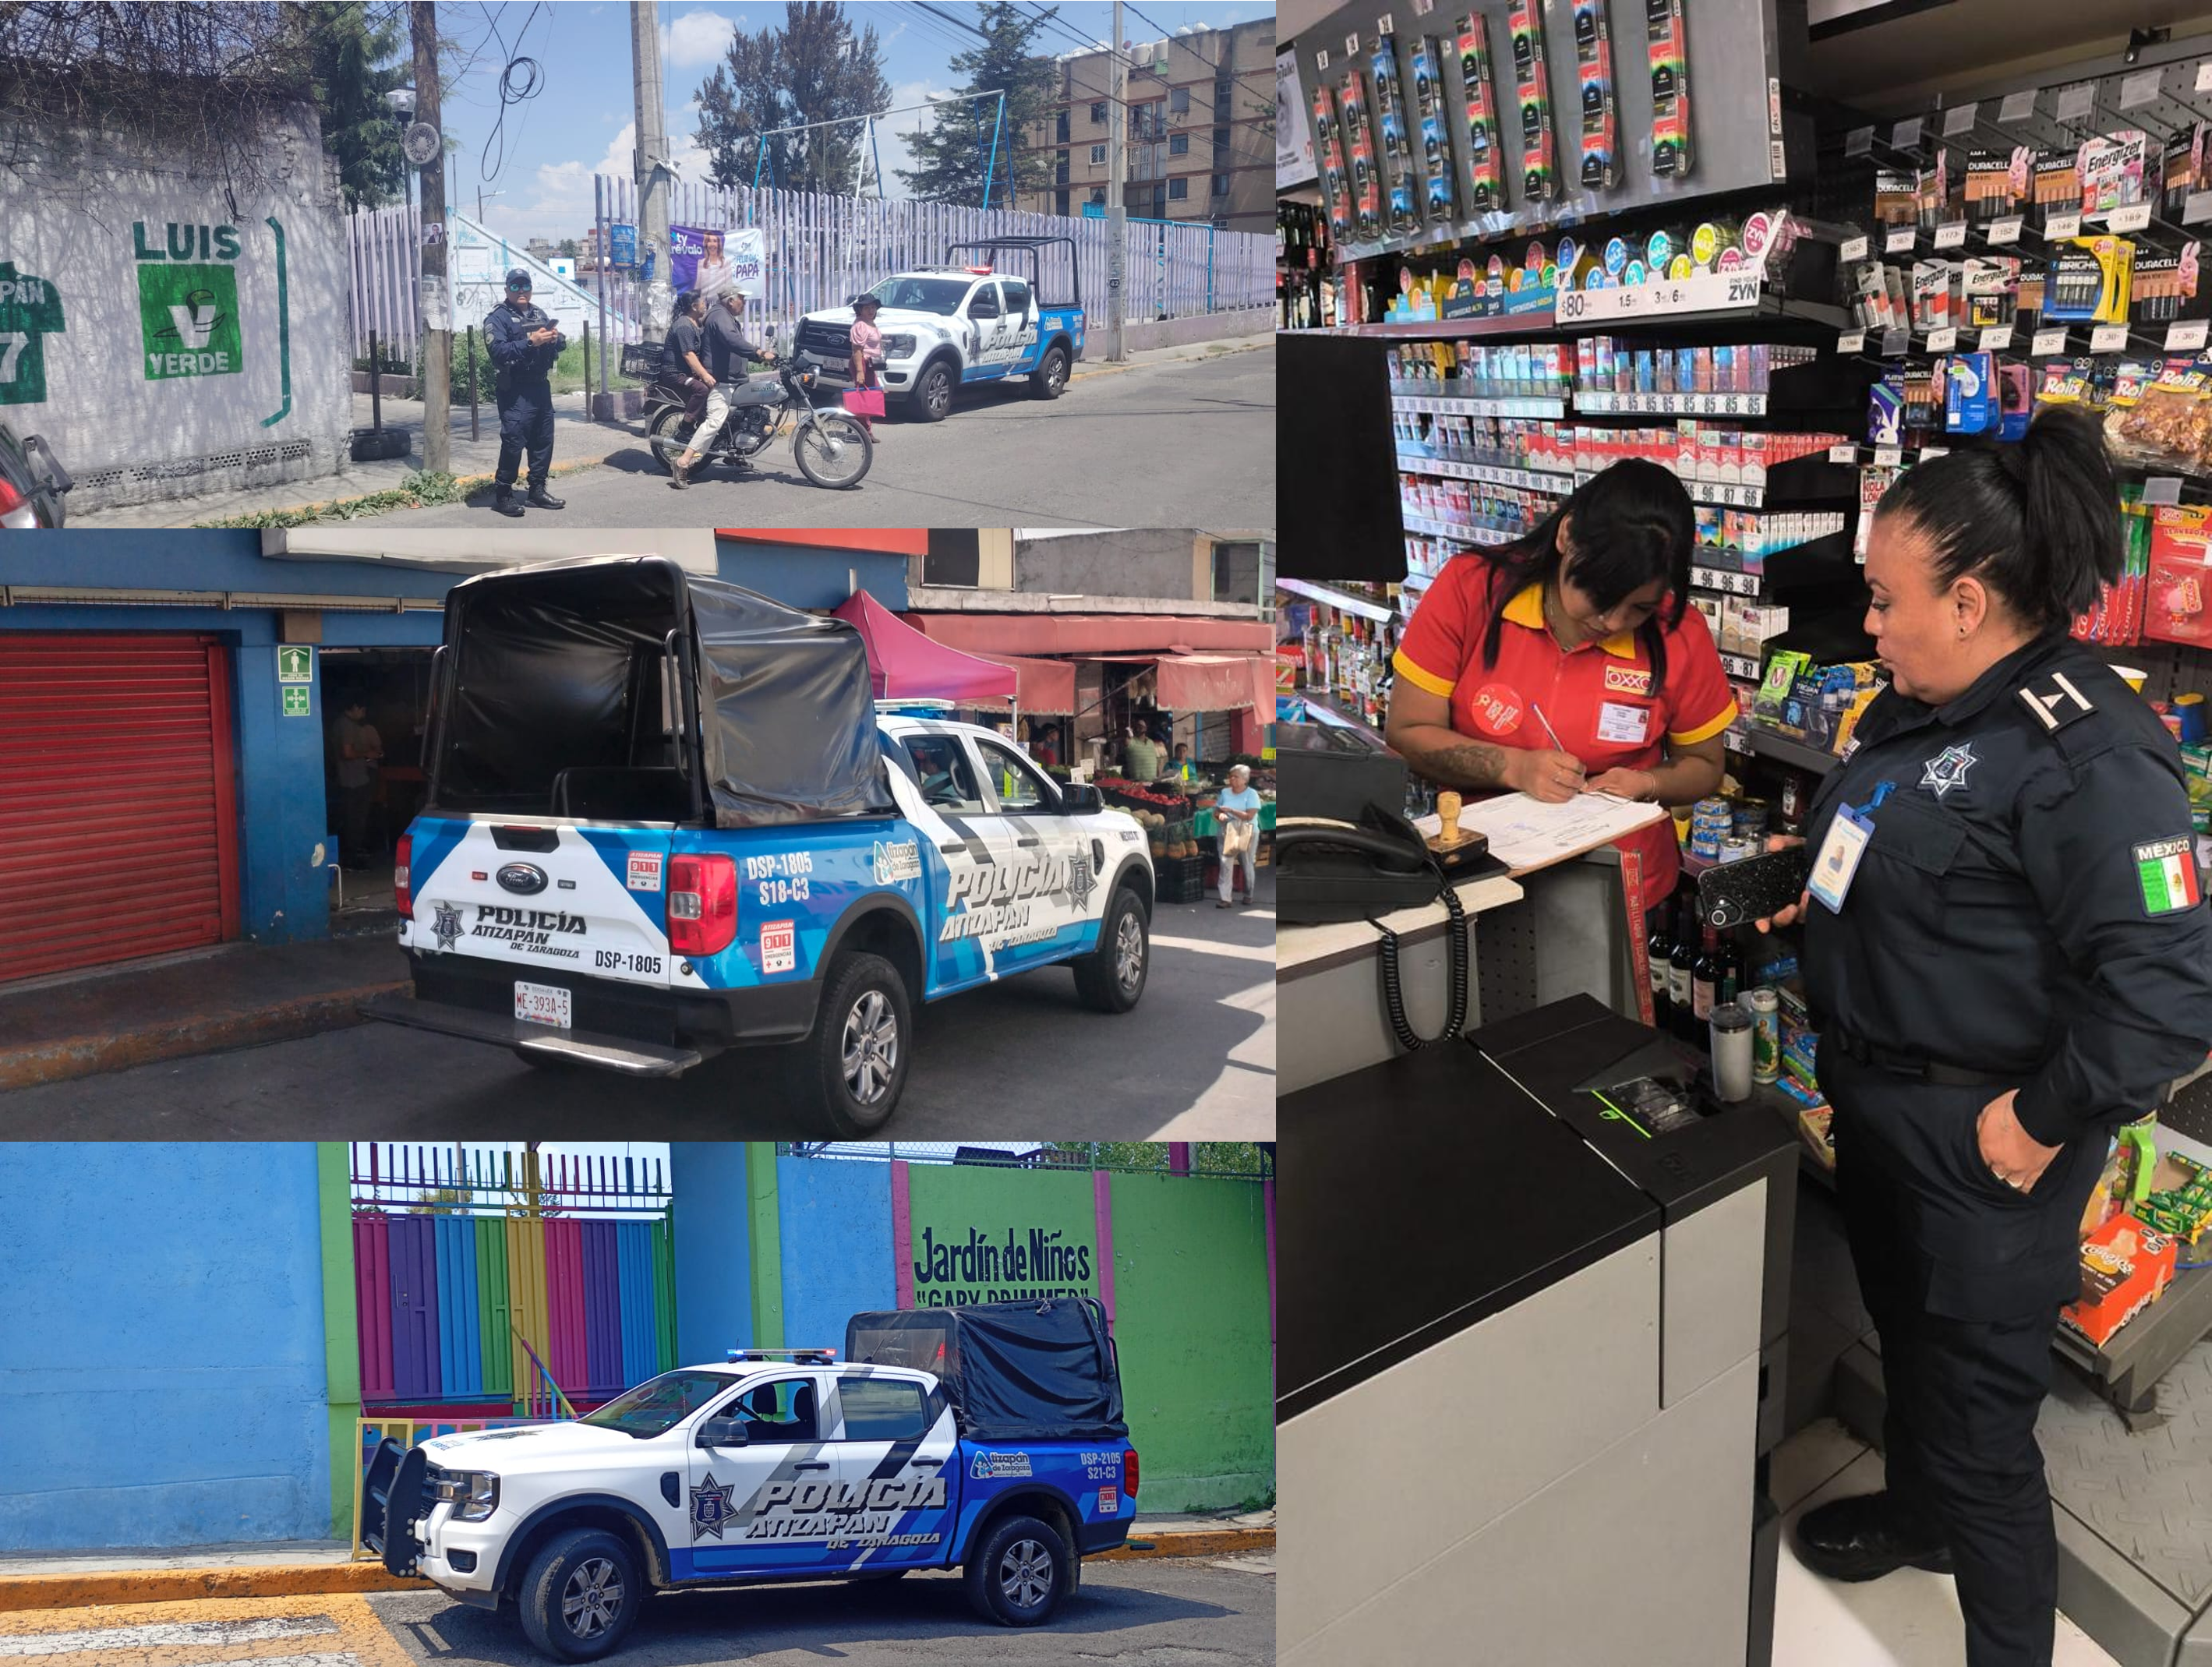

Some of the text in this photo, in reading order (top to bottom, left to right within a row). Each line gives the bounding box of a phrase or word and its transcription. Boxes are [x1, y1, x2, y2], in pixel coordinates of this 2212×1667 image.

[1968, 161, 2009, 171] DURACELL
[2036, 159, 2073, 171] DURACELL
[2087, 140, 2142, 173] Energizer
[1876, 184, 1916, 192] DURACELL
[133, 221, 241, 260] LUIS
[736, 261, 760, 278] PAPÁ
[2134, 259, 2178, 270] DURACELL
[1914, 267, 1948, 289] Energizer
[1972, 268, 2010, 284] Energizer
[1728, 282, 1758, 302] ZYN
[1561, 294, 1584, 317] $80
[149, 351, 229, 375] VERDE
[1684, 396, 1695, 411] 85
[1726, 397, 1737, 412] 85
[1863, 480, 1885, 492] KOLA
[1702, 486, 1714, 501] 96
[1723, 488, 1735, 503] 87
[1744, 489, 1758, 506] 66
[1701, 572, 1713, 588] 96
[1722, 574, 1734, 591] 96
[1723, 658, 1754, 676] 96 87
[1796, 682, 1819, 694] TROJAN
[2137, 839, 2190, 860] MÉXICO
[632, 862, 656, 872] 911
[747, 850, 813, 881] DSP-1805
[506, 871, 529, 885] Ford
[946, 856, 1065, 911] POLICÍA
[759, 877, 810, 906] S18-C3
[476, 904, 587, 934] POLICÍA
[939, 903, 1030, 943] ATIZAPÁN
[472, 924, 550, 945] ATIZAPÁN
[765, 933, 790, 949] 911
[511, 942, 579, 959] DE ZARAGOZA
[595, 950, 662, 974] DSP-1805
[516, 991, 568, 1015] ME-393A-5
[914, 1227, 1090, 1284] Jardín de Niños
[991, 1452, 1029, 1465] tizapán
[1080, 1452, 1121, 1465] DSP-2105
[1002, 1464, 1030, 1474] Zaragoza
[1087, 1467, 1116, 1479] S21-C3
[753, 1475, 947, 1516] POLICÍA
[745, 1512, 891, 1539] ATIZAPÁN
[826, 1533, 941, 1550] DE ZARAGOZA
